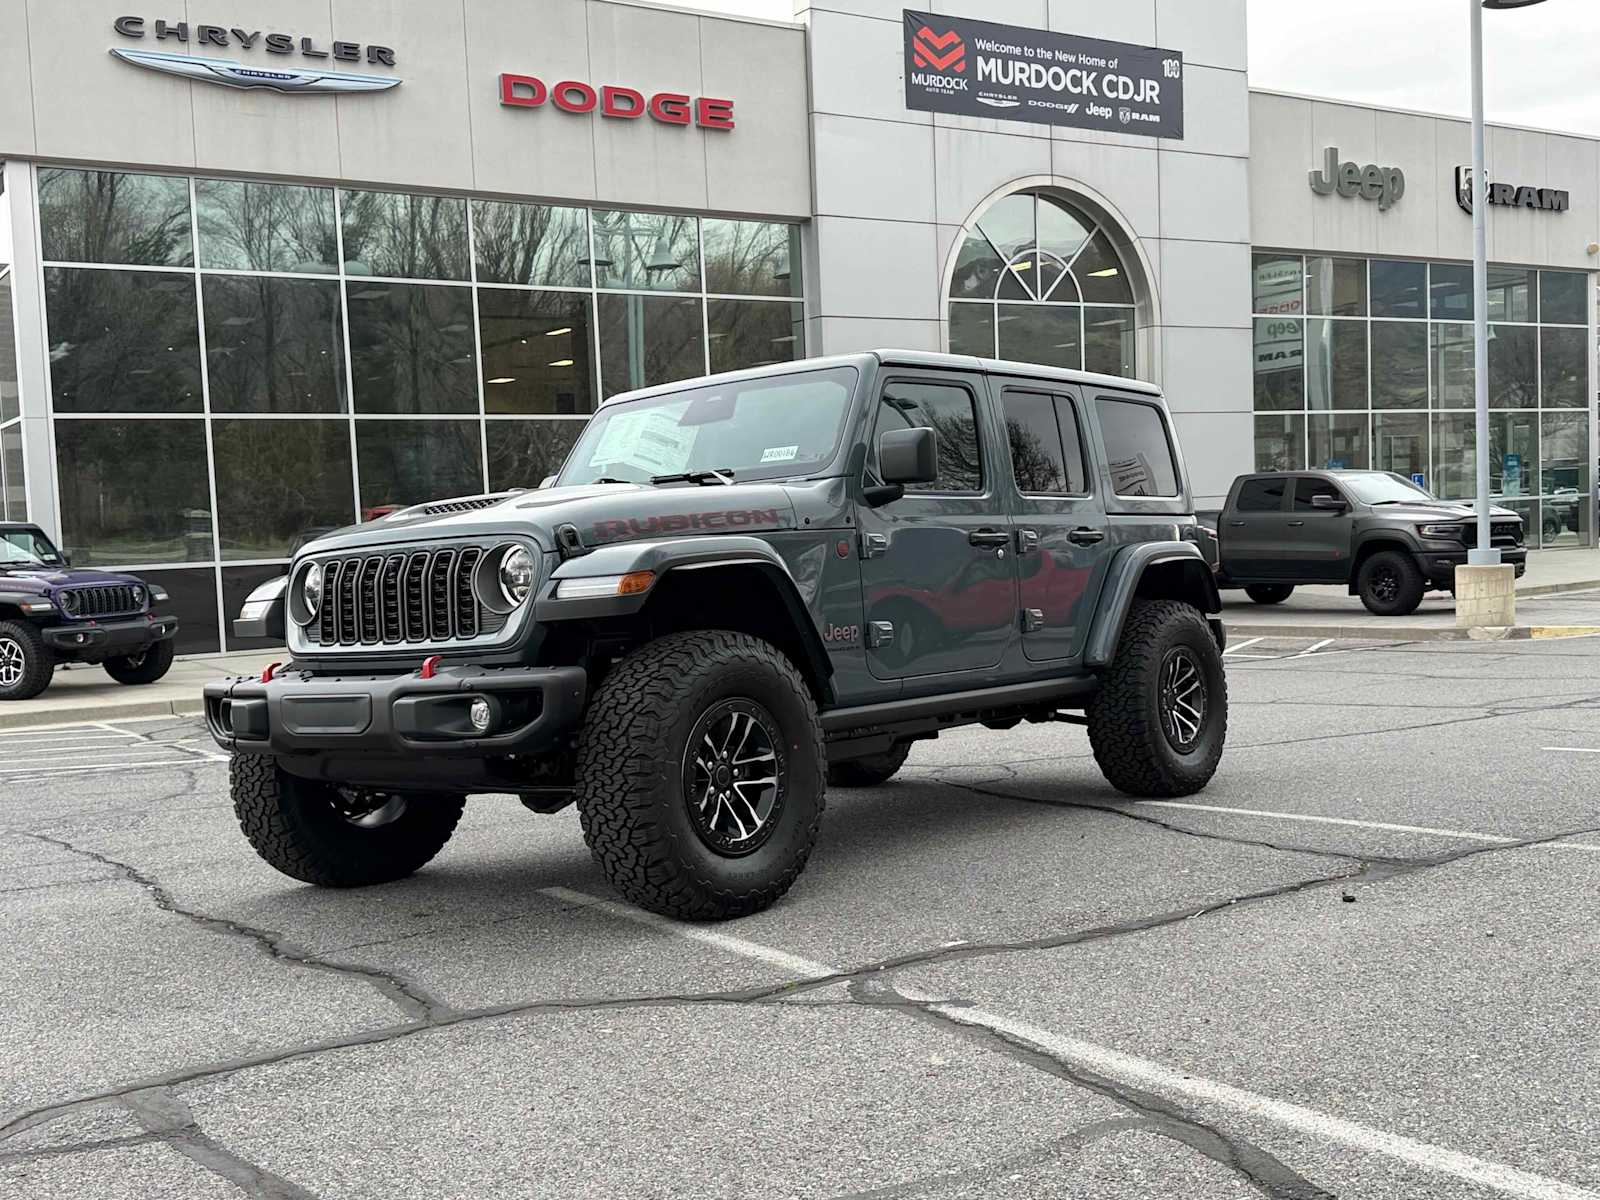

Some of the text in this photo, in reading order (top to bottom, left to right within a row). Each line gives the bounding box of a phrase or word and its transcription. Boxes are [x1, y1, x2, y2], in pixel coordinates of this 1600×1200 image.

[113, 16, 396, 65] CHRYSLER
[974, 38, 1118, 69] Welcome to the New Home of
[234, 69, 291, 80] CHRYSLER
[1162, 59, 1180, 78] 100
[911, 72, 968, 90] MURDOCK
[976, 55, 1160, 104] MURDOCK CDJR
[499, 73, 735, 131] DODGE
[978, 91, 1018, 100] CHRYSLER
[1028, 100, 1070, 110] DODGE
[1086, 102, 1112, 119] Jeep
[1131, 112, 1160, 122] RAM
[1309, 147, 1405, 211] Jeep
[1489, 183, 1569, 210] RAM
[592, 508, 779, 540] RUBICON
[824, 623, 859, 641] Jeep
